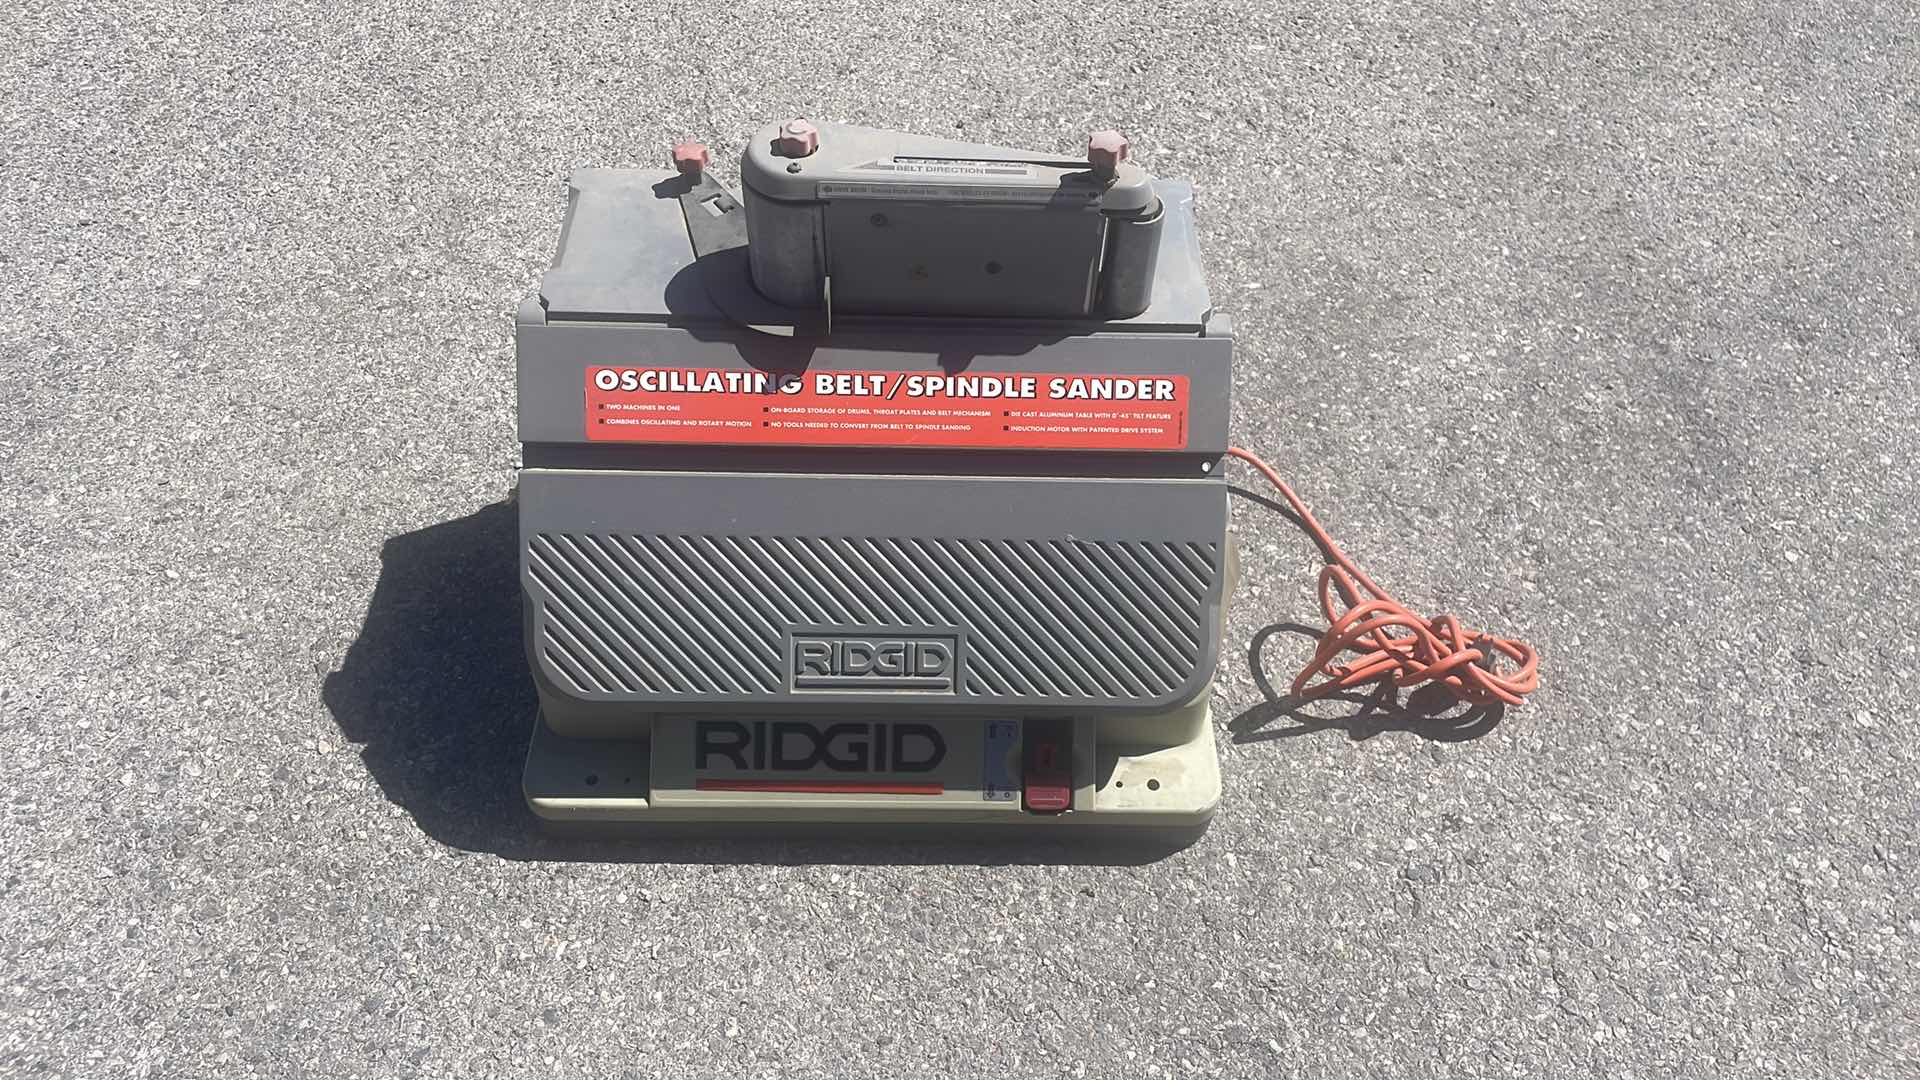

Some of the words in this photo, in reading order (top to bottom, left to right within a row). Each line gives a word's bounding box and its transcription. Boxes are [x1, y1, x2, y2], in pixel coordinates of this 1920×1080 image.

[926, 166, 984, 174] DIRECTION
[594, 368, 803, 394] OSCILLATING
[815, 374, 1036, 399] BELT/SPINDLE
[1048, 378, 1176, 400] SANDER
[794, 641, 953, 677] RIDGID
[694, 720, 947, 773] RIDGID
